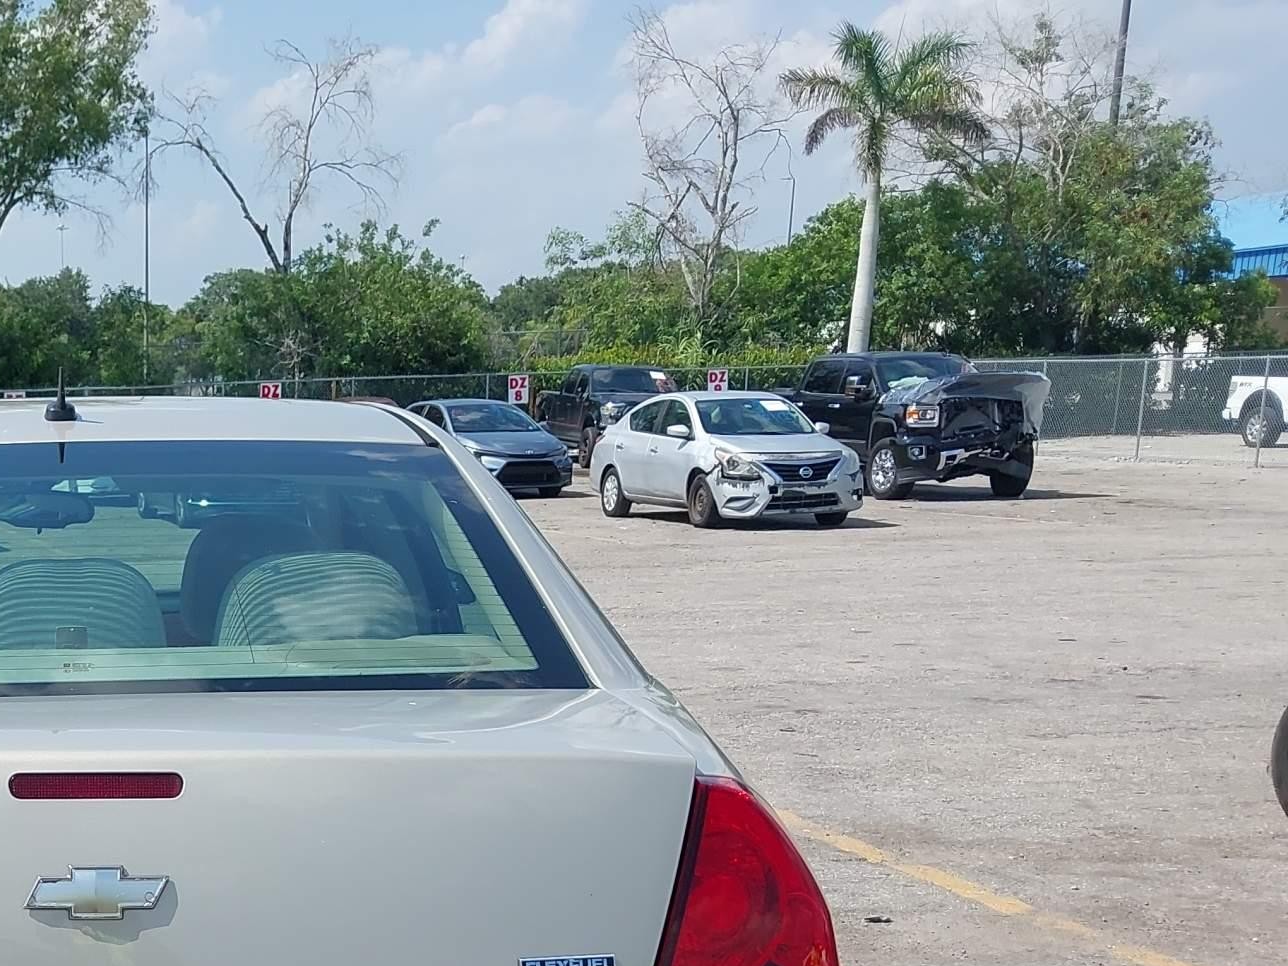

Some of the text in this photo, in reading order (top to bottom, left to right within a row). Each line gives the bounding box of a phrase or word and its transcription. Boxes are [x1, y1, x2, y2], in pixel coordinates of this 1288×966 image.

[509, 376, 528, 389] DZ
[709, 370, 727, 383] DZ
[262, 384, 280, 398] DZ
[515, 390, 523, 401] 8
